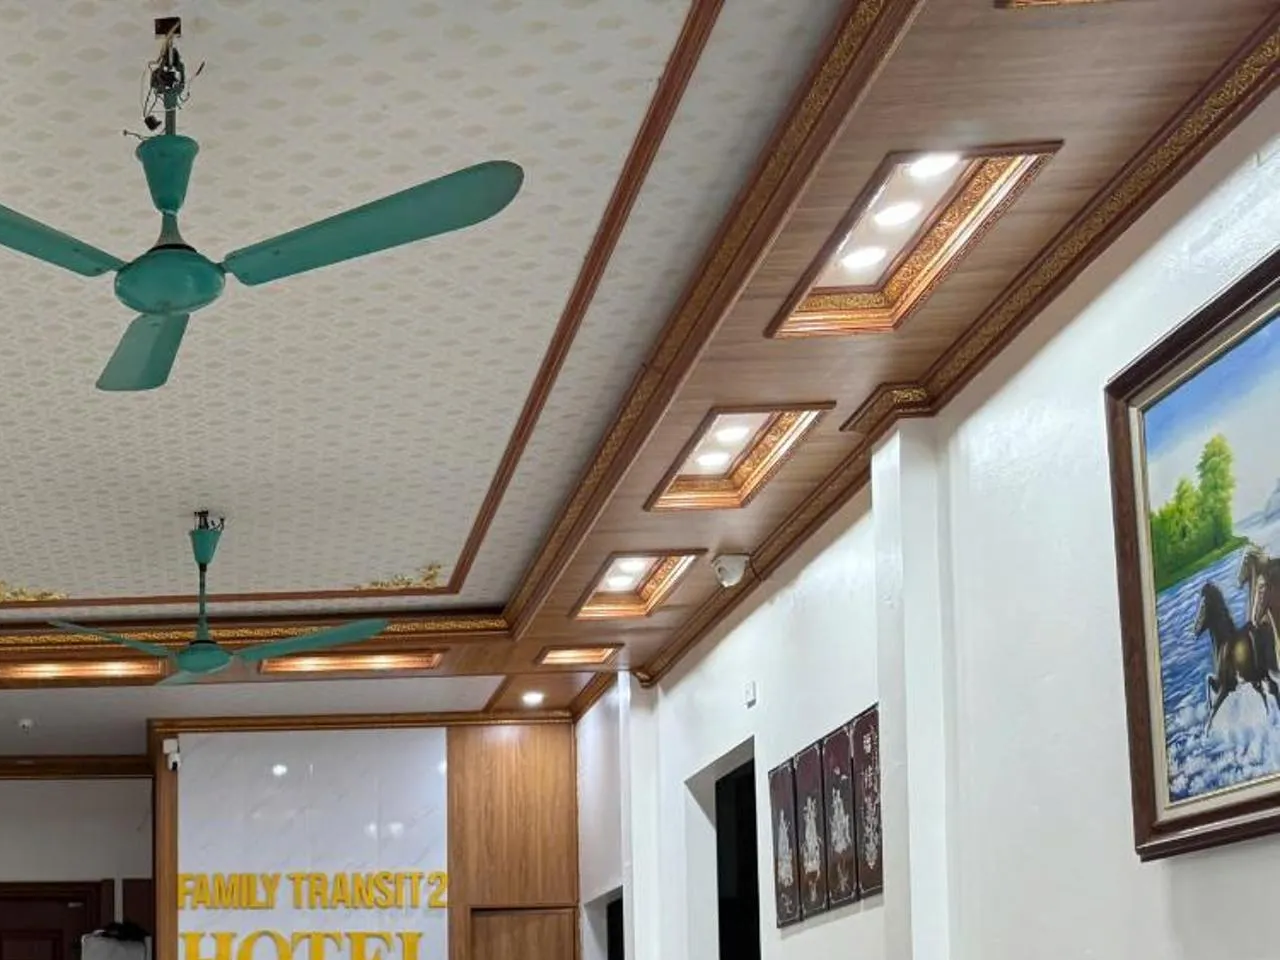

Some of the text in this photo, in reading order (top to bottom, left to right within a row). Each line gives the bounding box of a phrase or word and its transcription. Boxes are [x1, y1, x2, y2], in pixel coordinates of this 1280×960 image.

[177, 872, 447, 910] FAMILY TRANSIT 2
